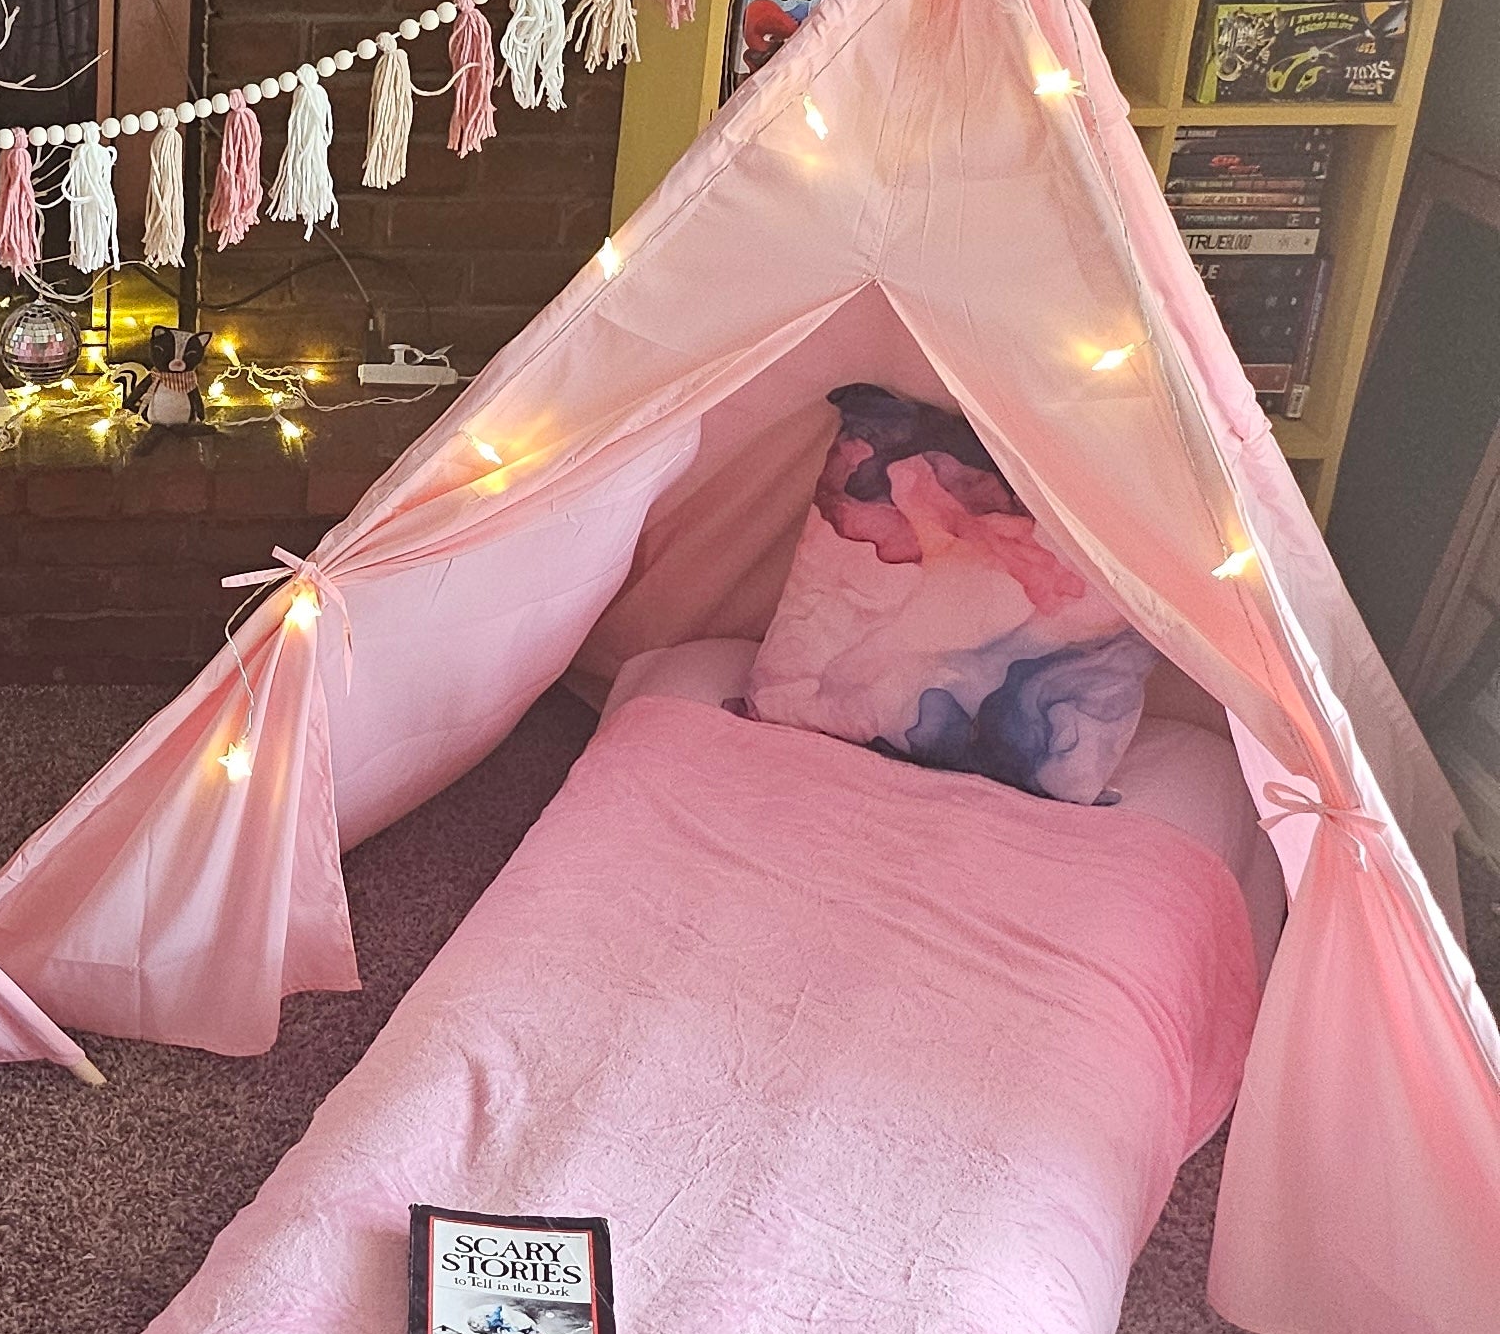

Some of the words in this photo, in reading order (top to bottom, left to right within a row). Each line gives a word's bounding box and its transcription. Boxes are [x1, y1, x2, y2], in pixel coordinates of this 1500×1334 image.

[454, 1235, 566, 1263] SCARY
[441, 1253, 582, 1285] STORIES
[454, 1276, 467, 1286] to
[468, 1275, 492, 1289] Tell
[497, 1280, 510, 1292] in
[513, 1282, 533, 1294] the
[536, 1284, 571, 1297] Dark
